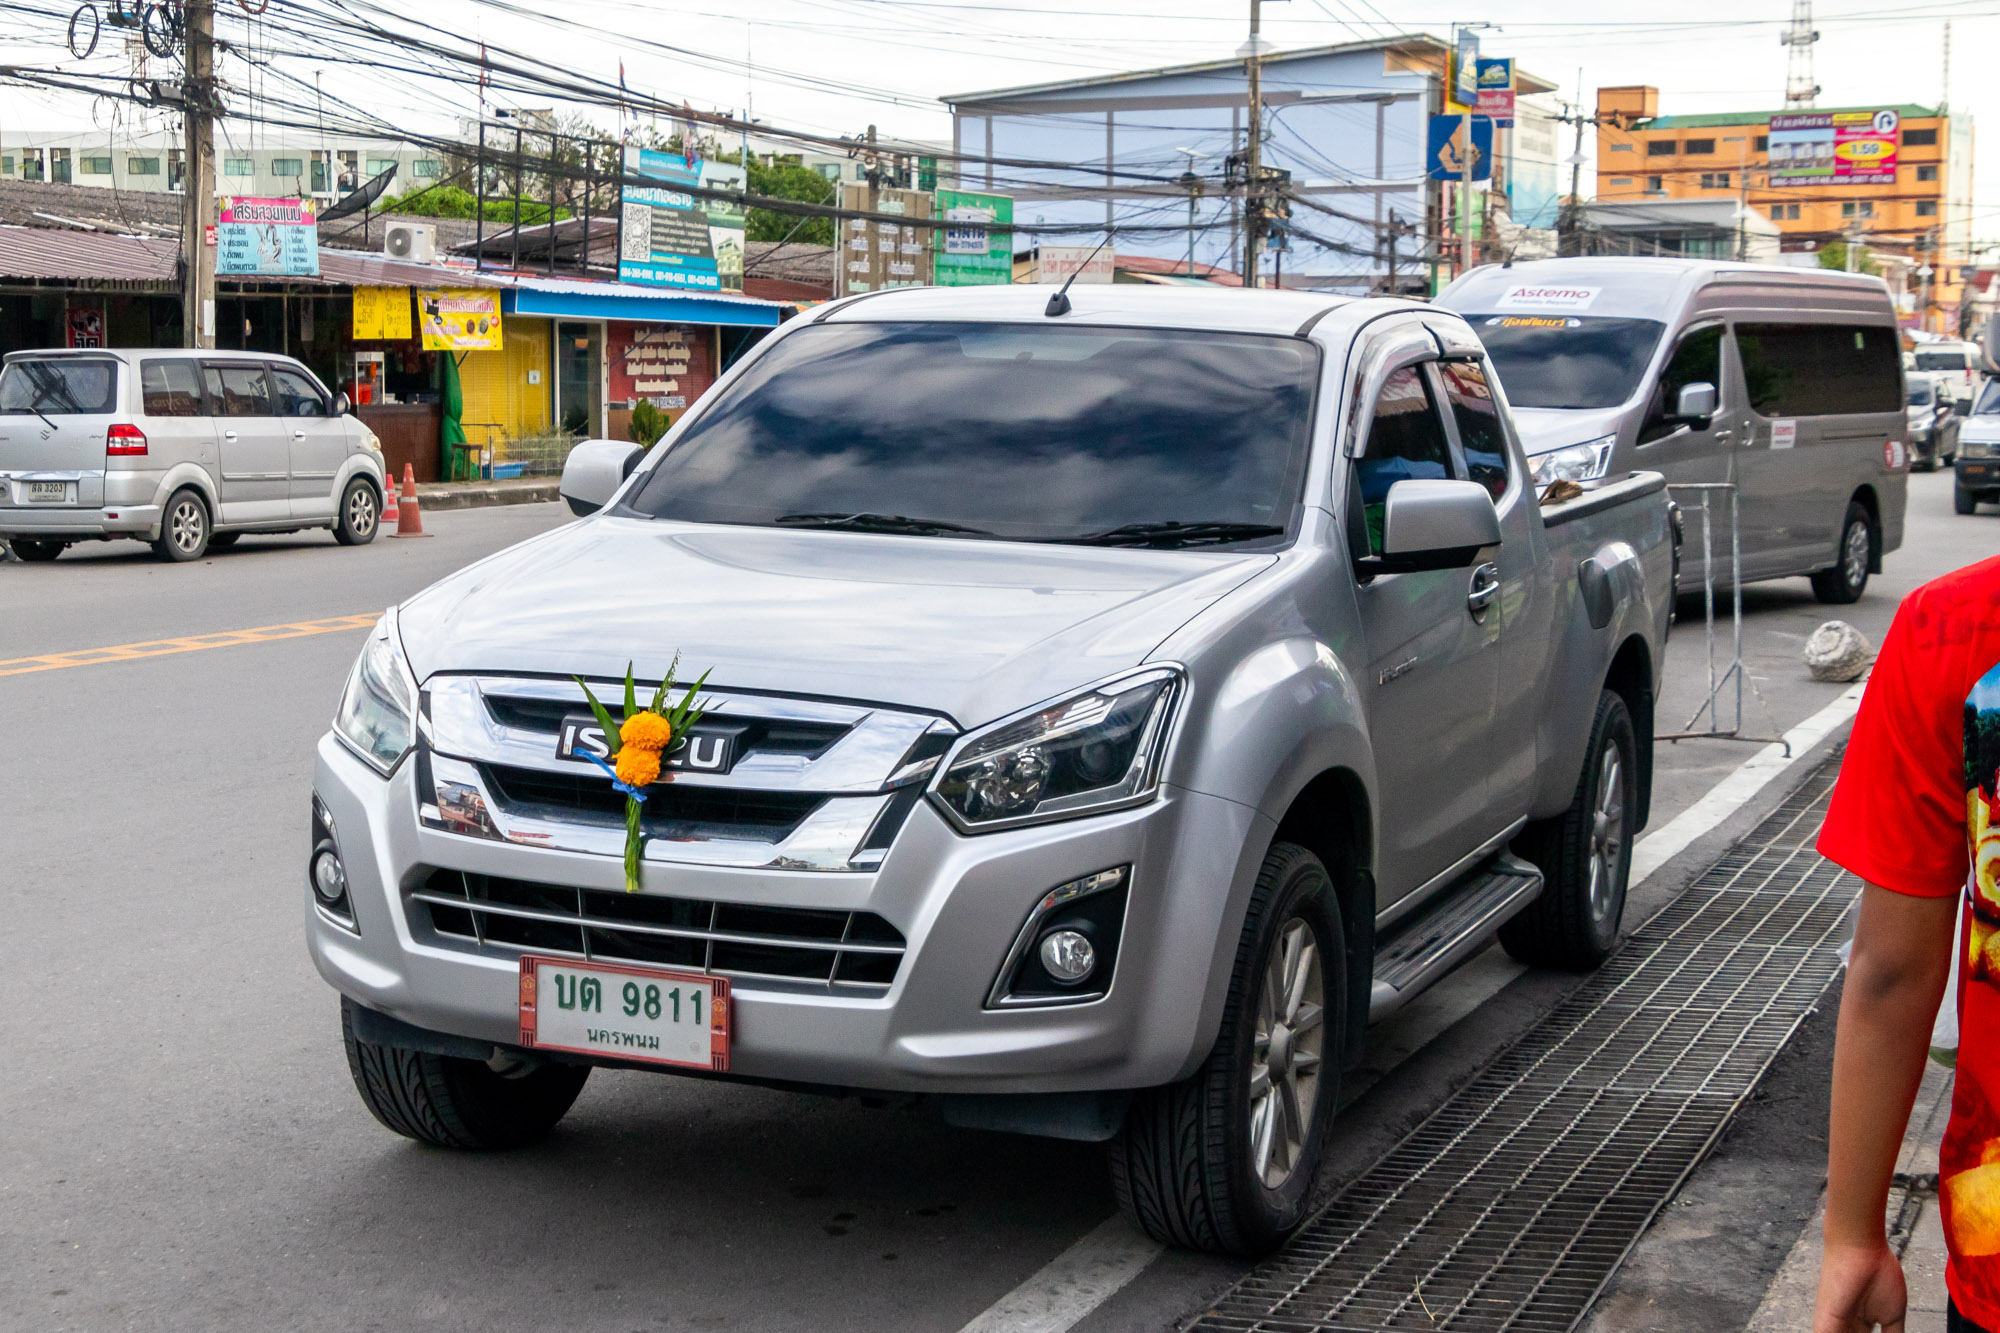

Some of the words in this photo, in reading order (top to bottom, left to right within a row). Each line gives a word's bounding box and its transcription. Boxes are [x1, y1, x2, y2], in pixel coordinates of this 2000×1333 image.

[1511, 287, 1591, 299] Astemo
[44, 483, 63, 493] 3203
[562, 725, 726, 768] ISU
[622, 981, 702, 1025] 9811
[587, 1027, 660, 1050] นครพนม
